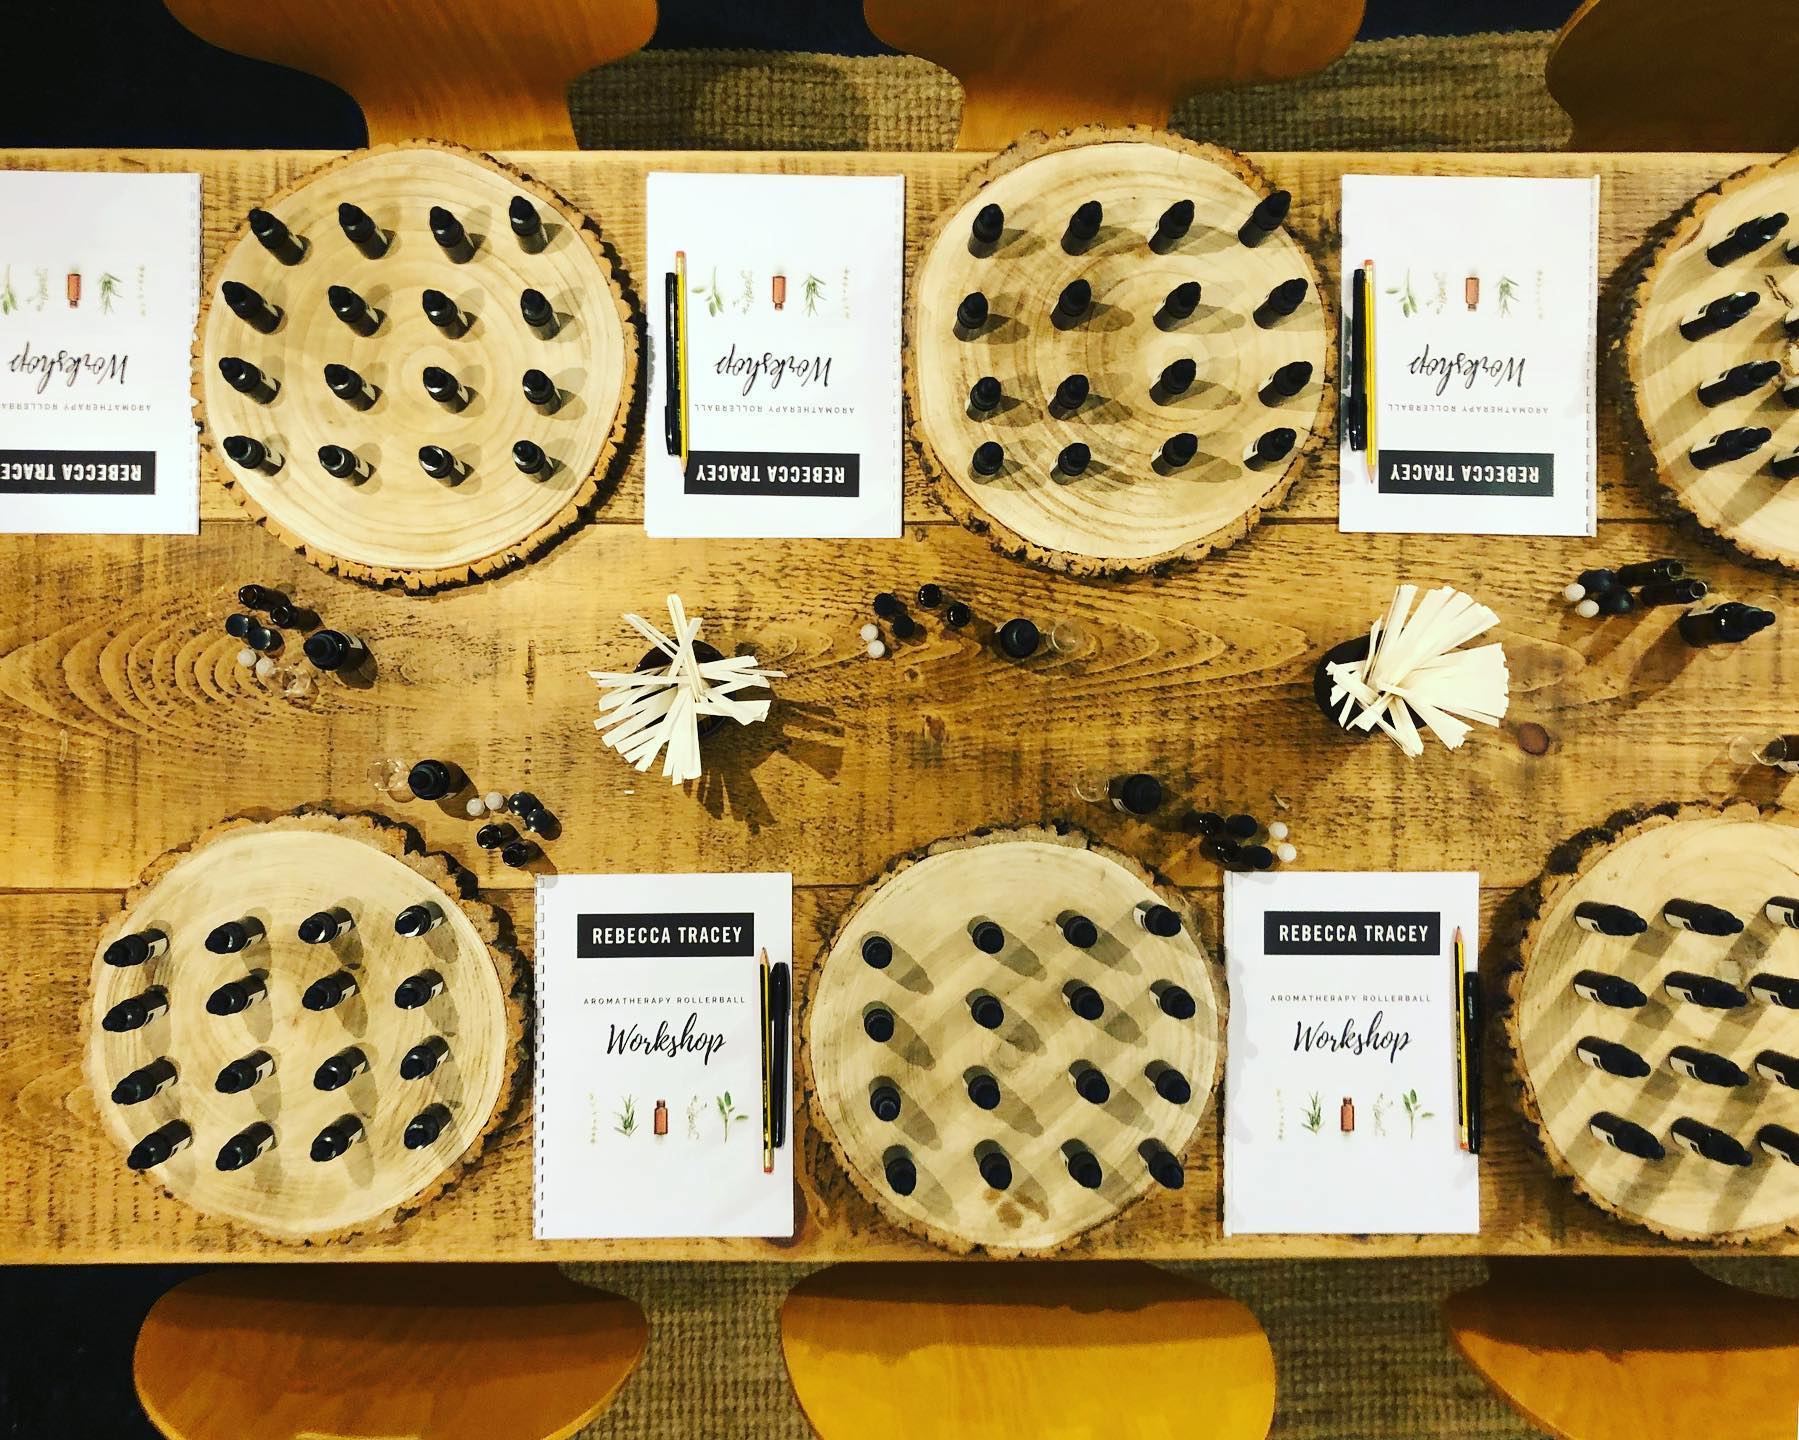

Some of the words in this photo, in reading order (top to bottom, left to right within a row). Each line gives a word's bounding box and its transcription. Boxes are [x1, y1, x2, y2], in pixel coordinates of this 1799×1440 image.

[8, 341, 129, 395] Workshop
[715, 344, 832, 396] Workshop
[1408, 344, 1525, 396] Workshop
[63, 403, 151, 412] AROMATHERAPY
[694, 403, 763, 413] ROLLERBALL
[768, 405, 855, 415] AROMATHERAPY
[1387, 403, 1456, 413] ROLLERBALL
[1462, 405, 1549, 414] AROMATHERAPY
[62, 464, 141, 481] REBECCA
[696, 465, 760, 482] TRACEY
[767, 466, 844, 483] REBECCA
[1391, 464, 1454, 481] TRACEY
[1461, 466, 1539, 483] REBECCA
[593, 927, 670, 944] REBECCA
[678, 927, 741, 943] TRACEY
[1280, 925, 1356, 941] REBECCA
[1364, 925, 1428, 942] TRACEY
[583, 996, 671, 1006] AROMATHERAPY
[676, 995, 745, 1004] ROLLERBALL
[1270, 994, 1356, 1003] AROMATHERAPY
[1362, 994, 1431, 1003] ROLLERBALL
[607, 1012, 726, 1066] Workshop
[1294, 1011, 1410, 1063] Workshop
